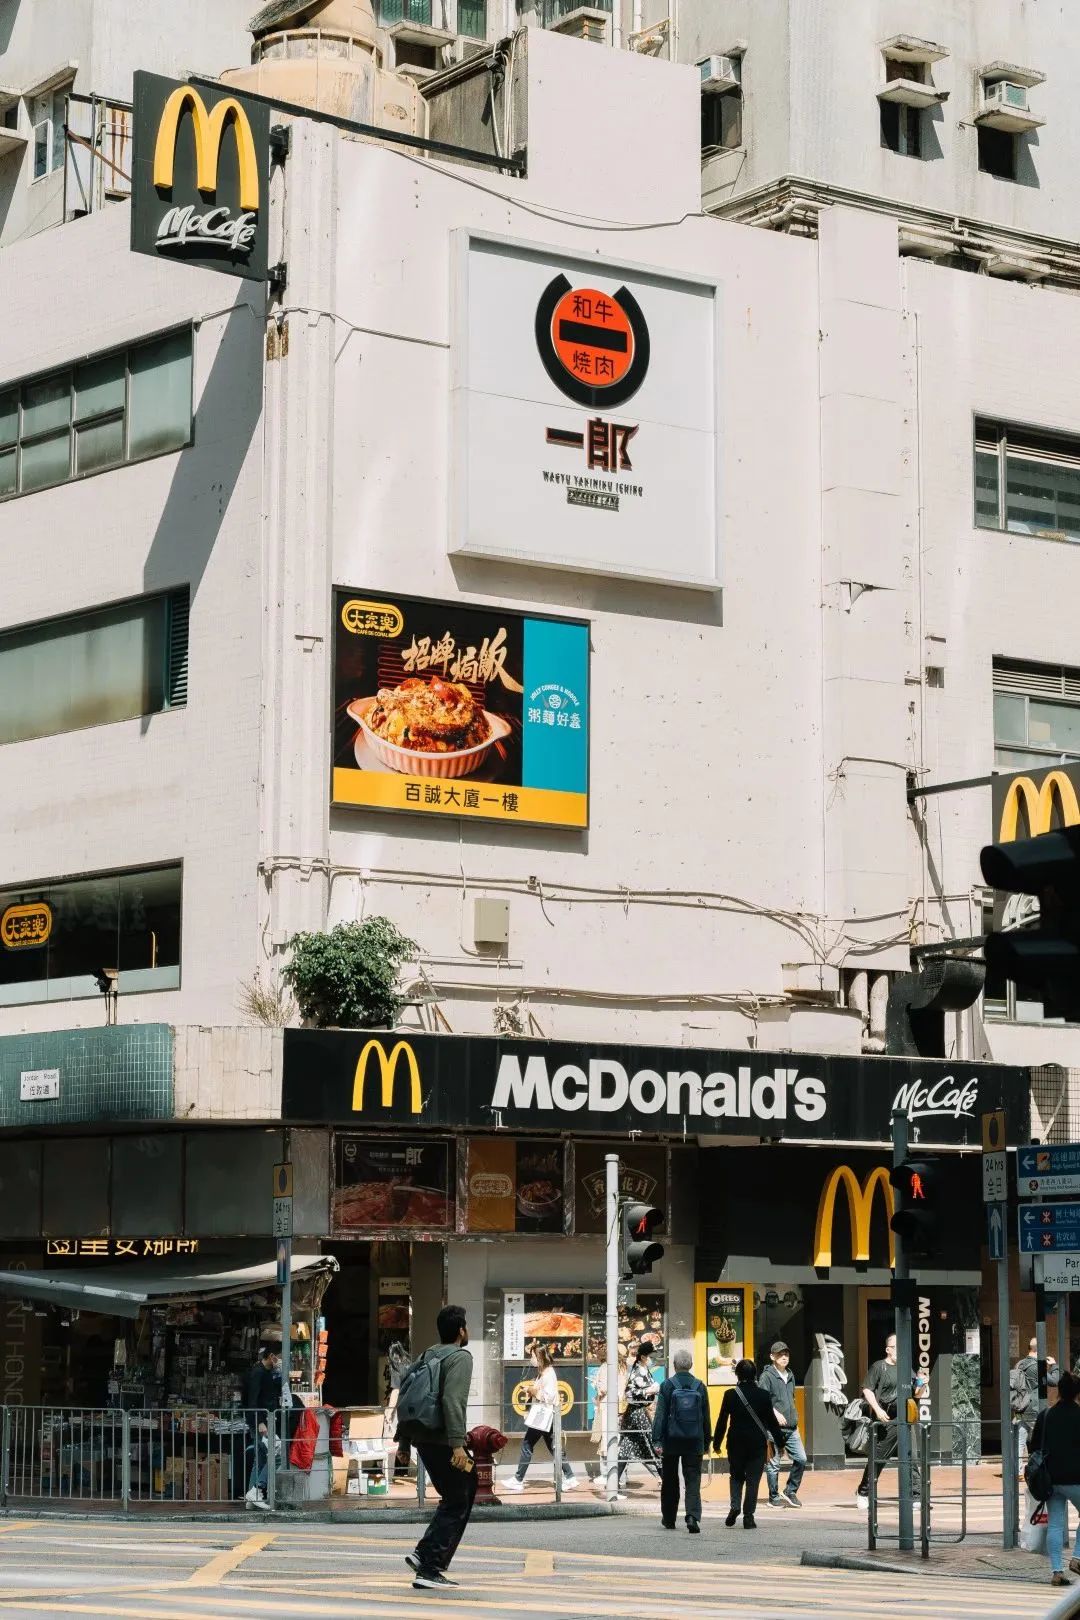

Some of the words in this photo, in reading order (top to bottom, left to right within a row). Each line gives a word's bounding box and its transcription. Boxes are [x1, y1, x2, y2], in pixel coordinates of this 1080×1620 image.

[157, 204, 257, 250] McCafé
[572, 295, 614, 323] 和牛
[545, 416, 640, 474] 一郎
[542, 470, 571, 486] WAGYU
[573, 475, 613, 493] YAKINIKU
[615, 482, 643, 497] ICHIRO
[350, 609, 395, 632] 大家樂
[404, 782, 519, 813] 百誠大廈一樓
[8, 914, 45, 939] 大家樂
[43, 1072, 57, 1080] Road
[491, 1054, 827, 1122] McDonald's
[892, 1075, 979, 1121] McCafé
[985, 1158, 993, 1172] 24
[994, 1159, 1004, 1171] hrs
[710, 1294, 740, 1304] OREO
